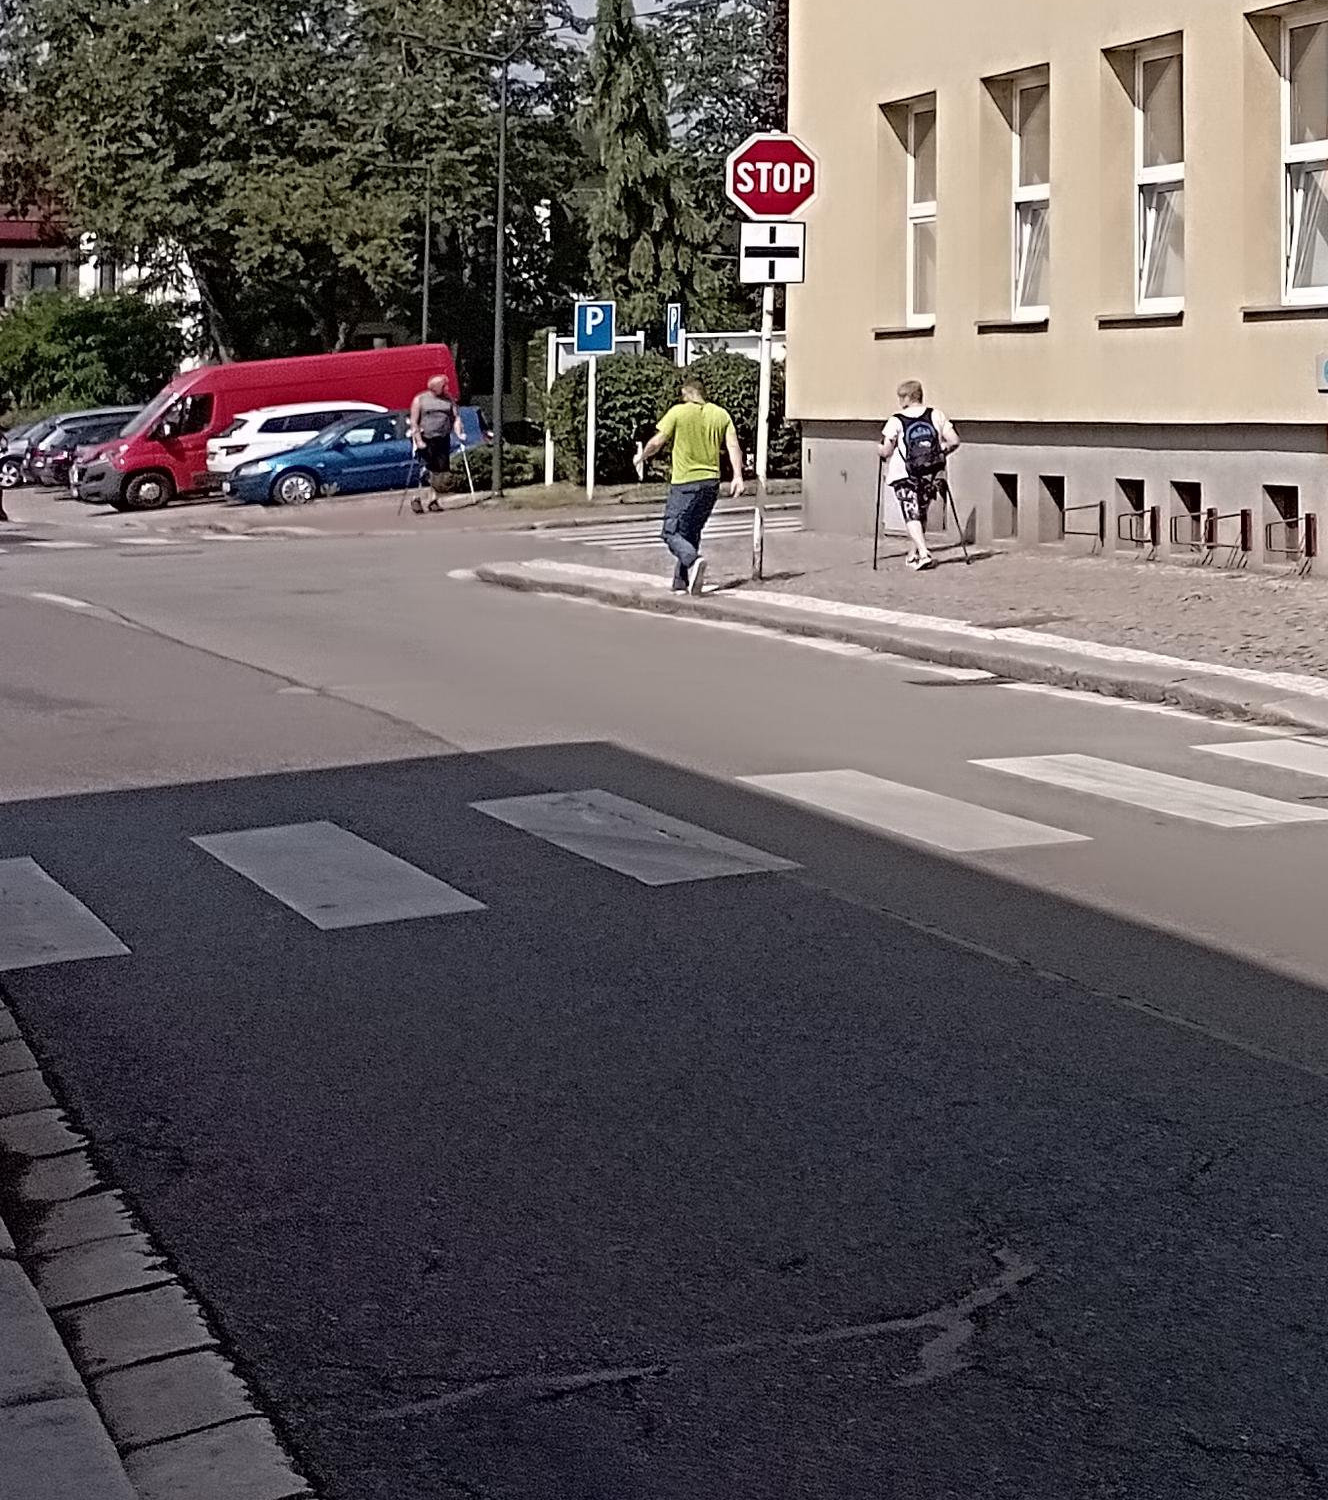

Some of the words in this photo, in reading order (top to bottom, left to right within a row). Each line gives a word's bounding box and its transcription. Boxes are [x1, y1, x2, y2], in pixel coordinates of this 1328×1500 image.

[736, 161, 812, 194] STOP
[585, 306, 604, 336] P
[670, 307, 677, 331] P
